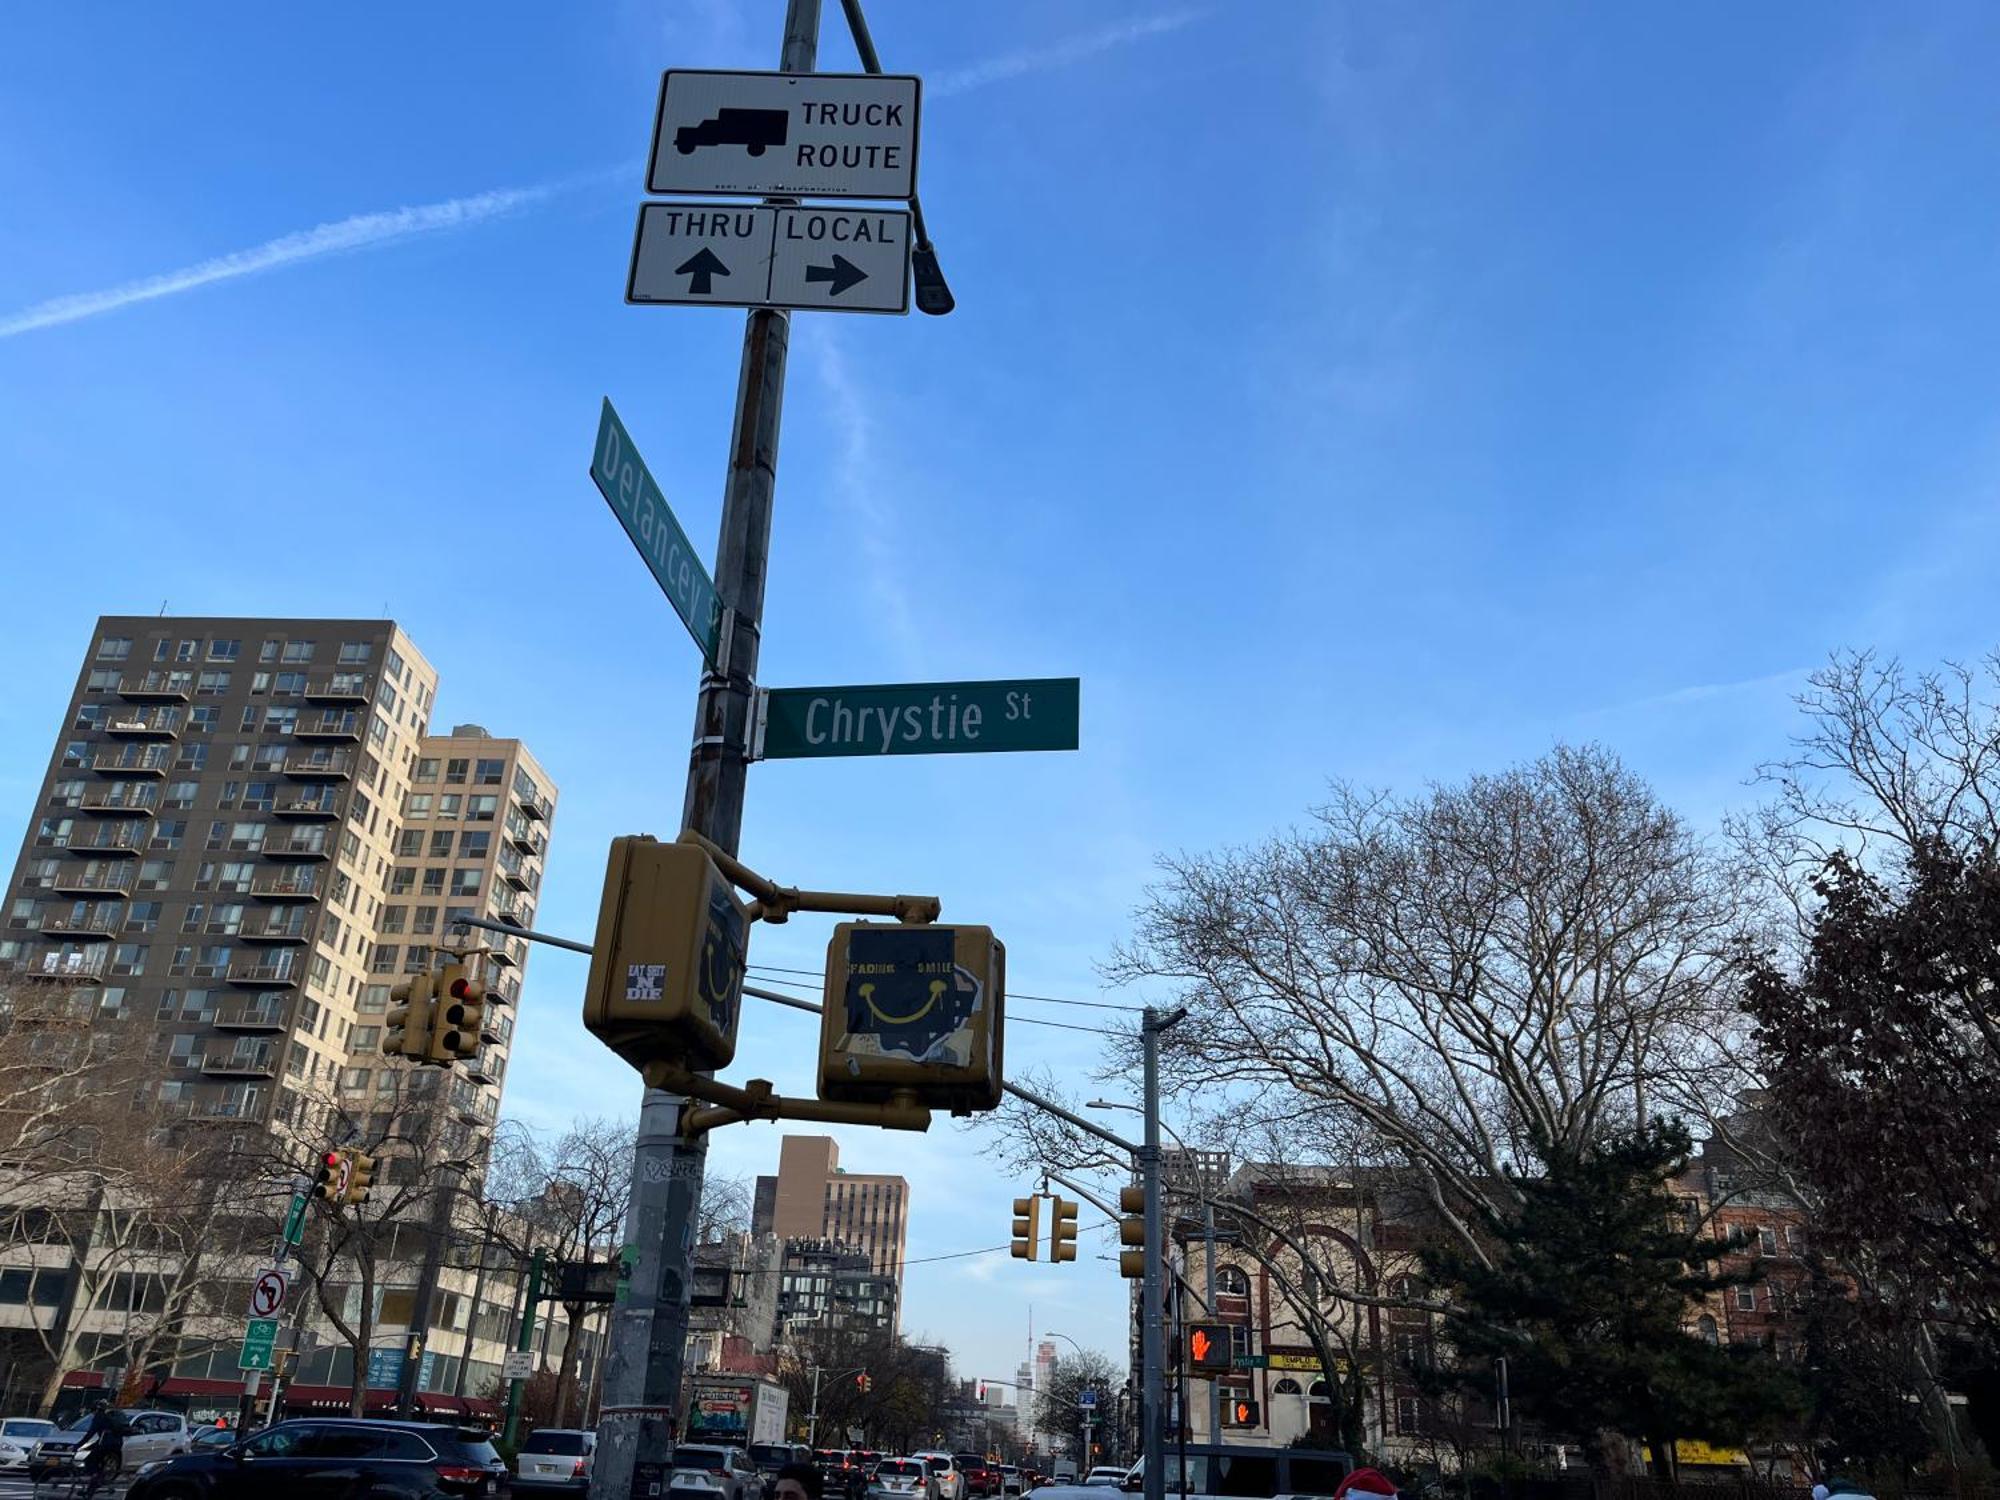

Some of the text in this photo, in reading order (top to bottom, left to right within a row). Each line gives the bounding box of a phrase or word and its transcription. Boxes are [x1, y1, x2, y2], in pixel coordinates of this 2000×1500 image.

[802, 102, 903, 127] TRUCK
[797, 145, 900, 169] ROUTE
[666, 212, 755, 238] THRU
[787, 215, 895, 244] LOCAL
[601, 422, 702, 625] Delancey
[805, 691, 1032, 754] Chrystie St
[626, 988, 663, 1000] DIE
[636, 976, 655, 988] N
